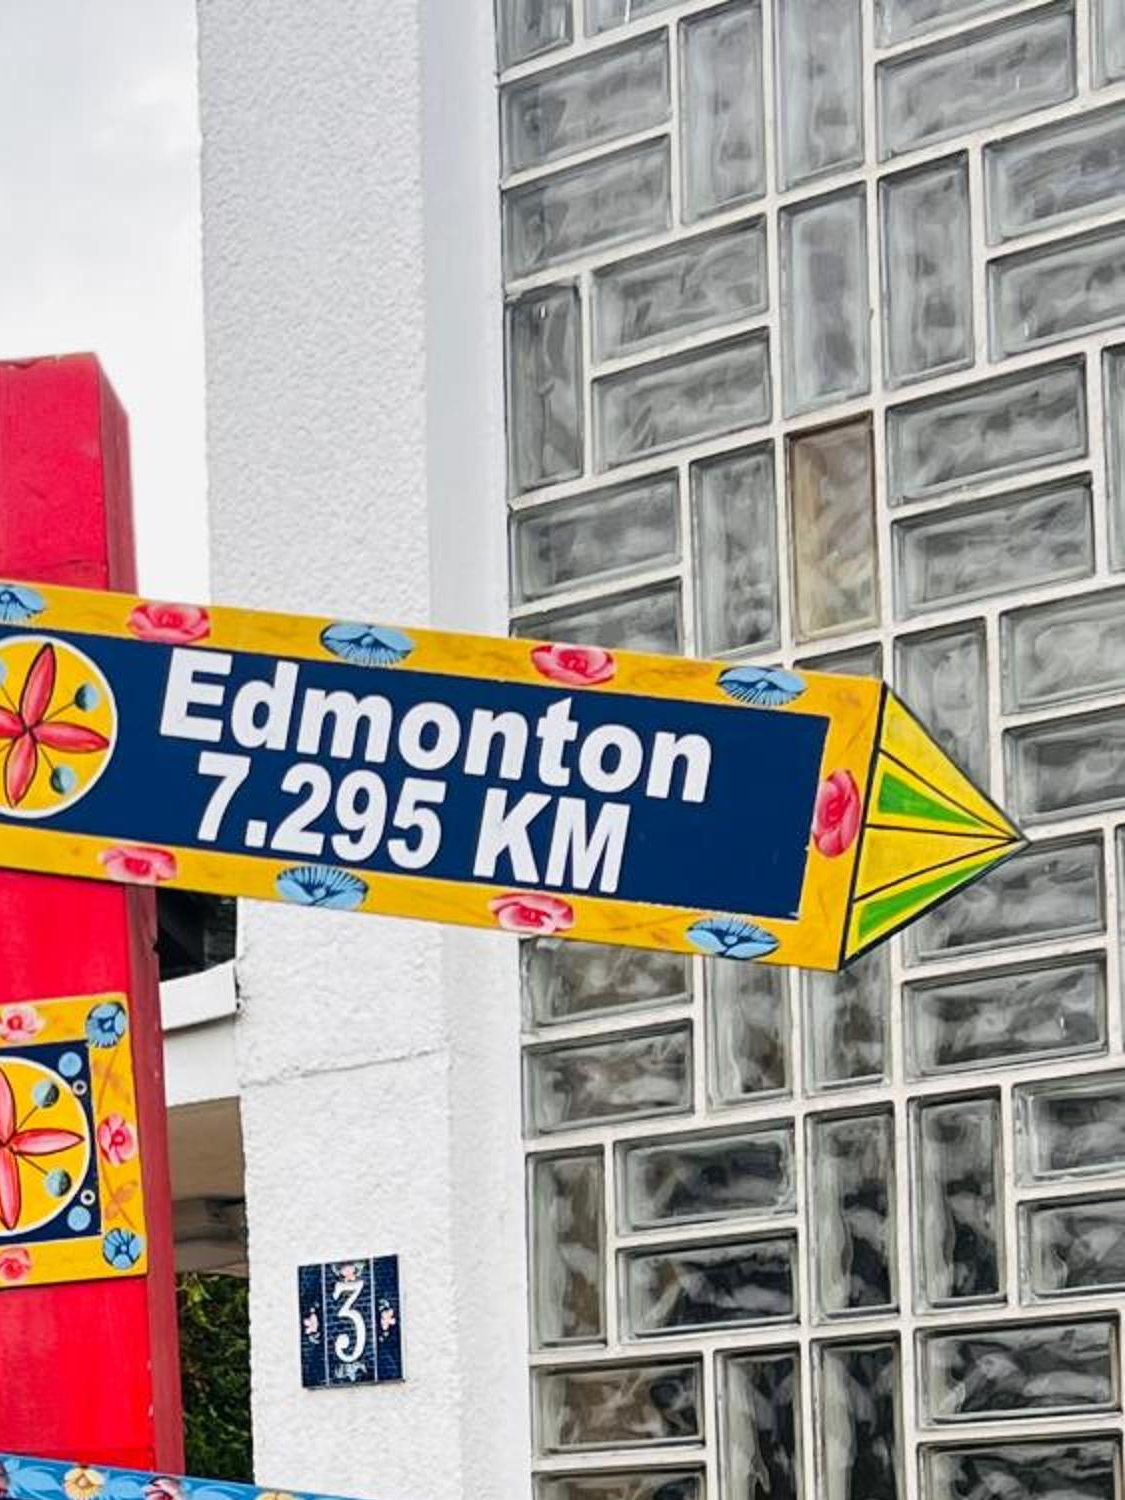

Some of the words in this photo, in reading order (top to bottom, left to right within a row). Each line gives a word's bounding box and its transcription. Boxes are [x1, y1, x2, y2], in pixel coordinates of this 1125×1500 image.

[160, 647, 712, 803] Edmonton
[198, 751, 446, 869] 7.295
[473, 788, 630, 893] KM
[332, 1280, 367, 1363] 3
